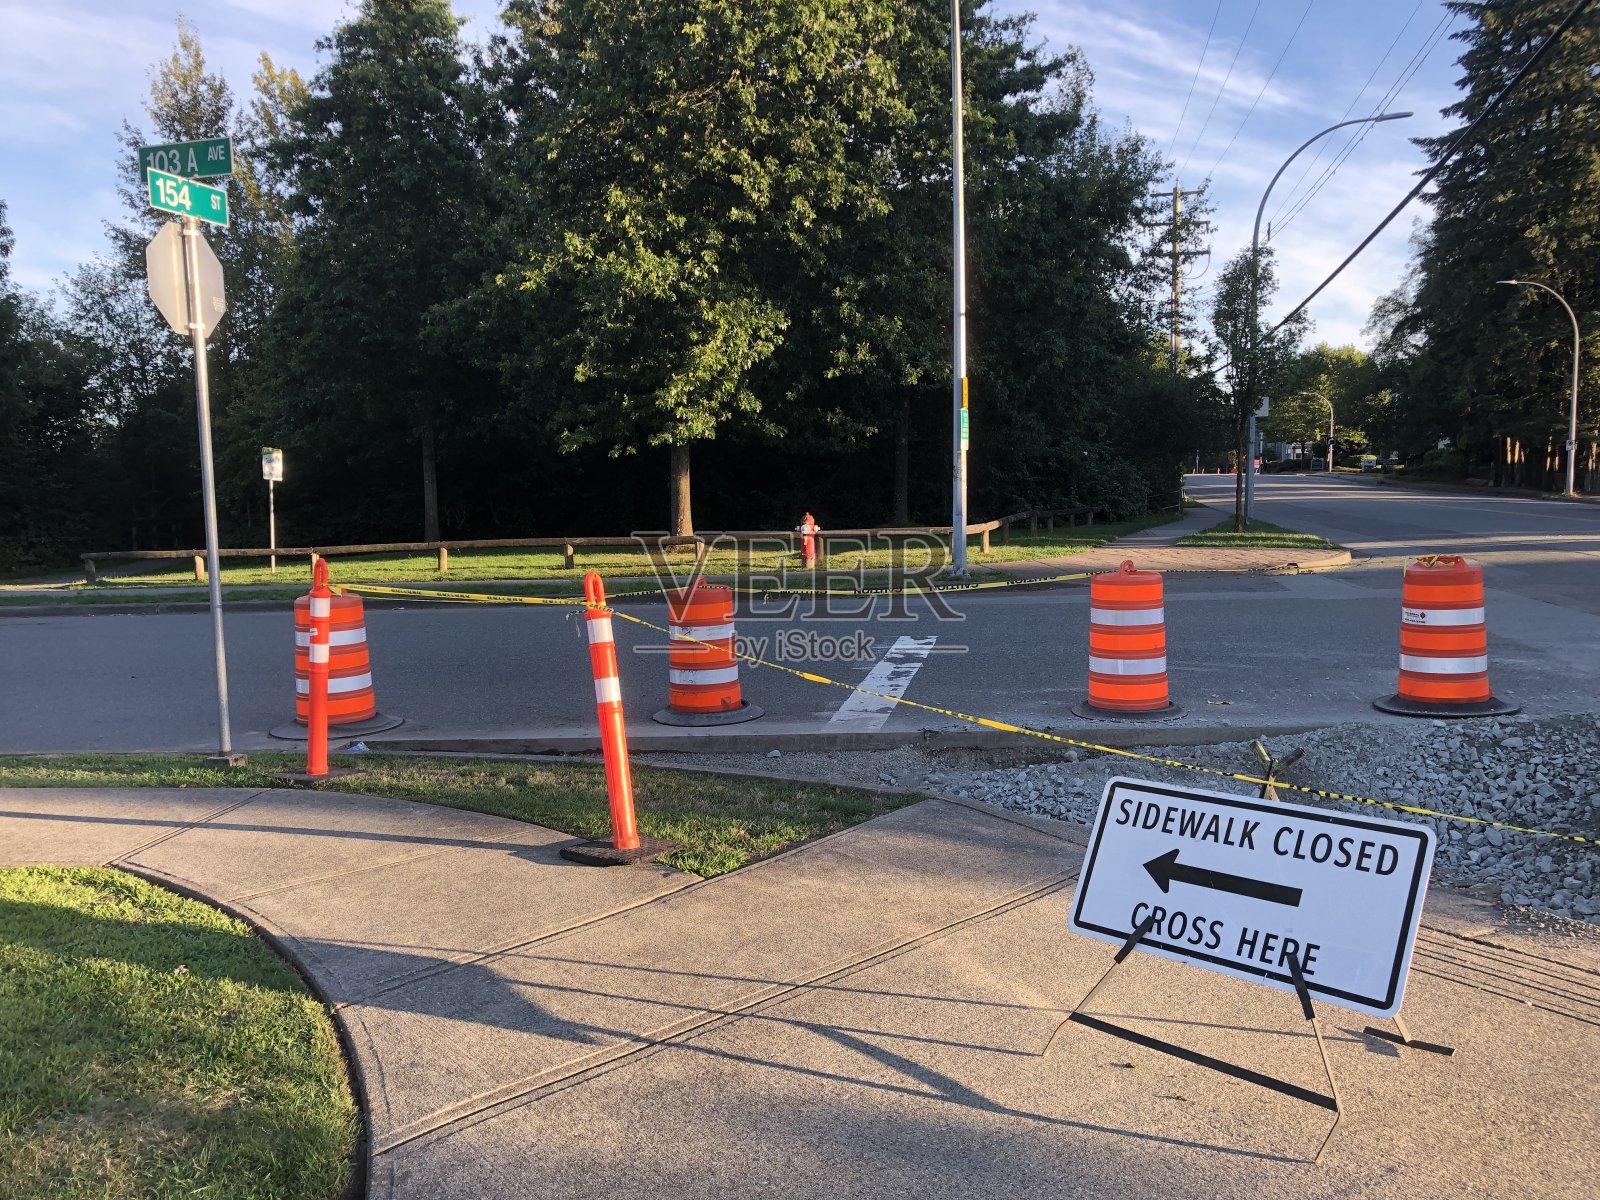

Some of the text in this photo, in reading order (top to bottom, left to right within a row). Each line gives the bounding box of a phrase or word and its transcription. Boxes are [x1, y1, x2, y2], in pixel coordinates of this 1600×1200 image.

[147, 145, 225, 174] 103 A AVE
[156, 178, 221, 210] 154 ST
[1116, 798, 1399, 876] SIDEWALK CLOSED
[1131, 902, 1320, 976] CROSS HERE
